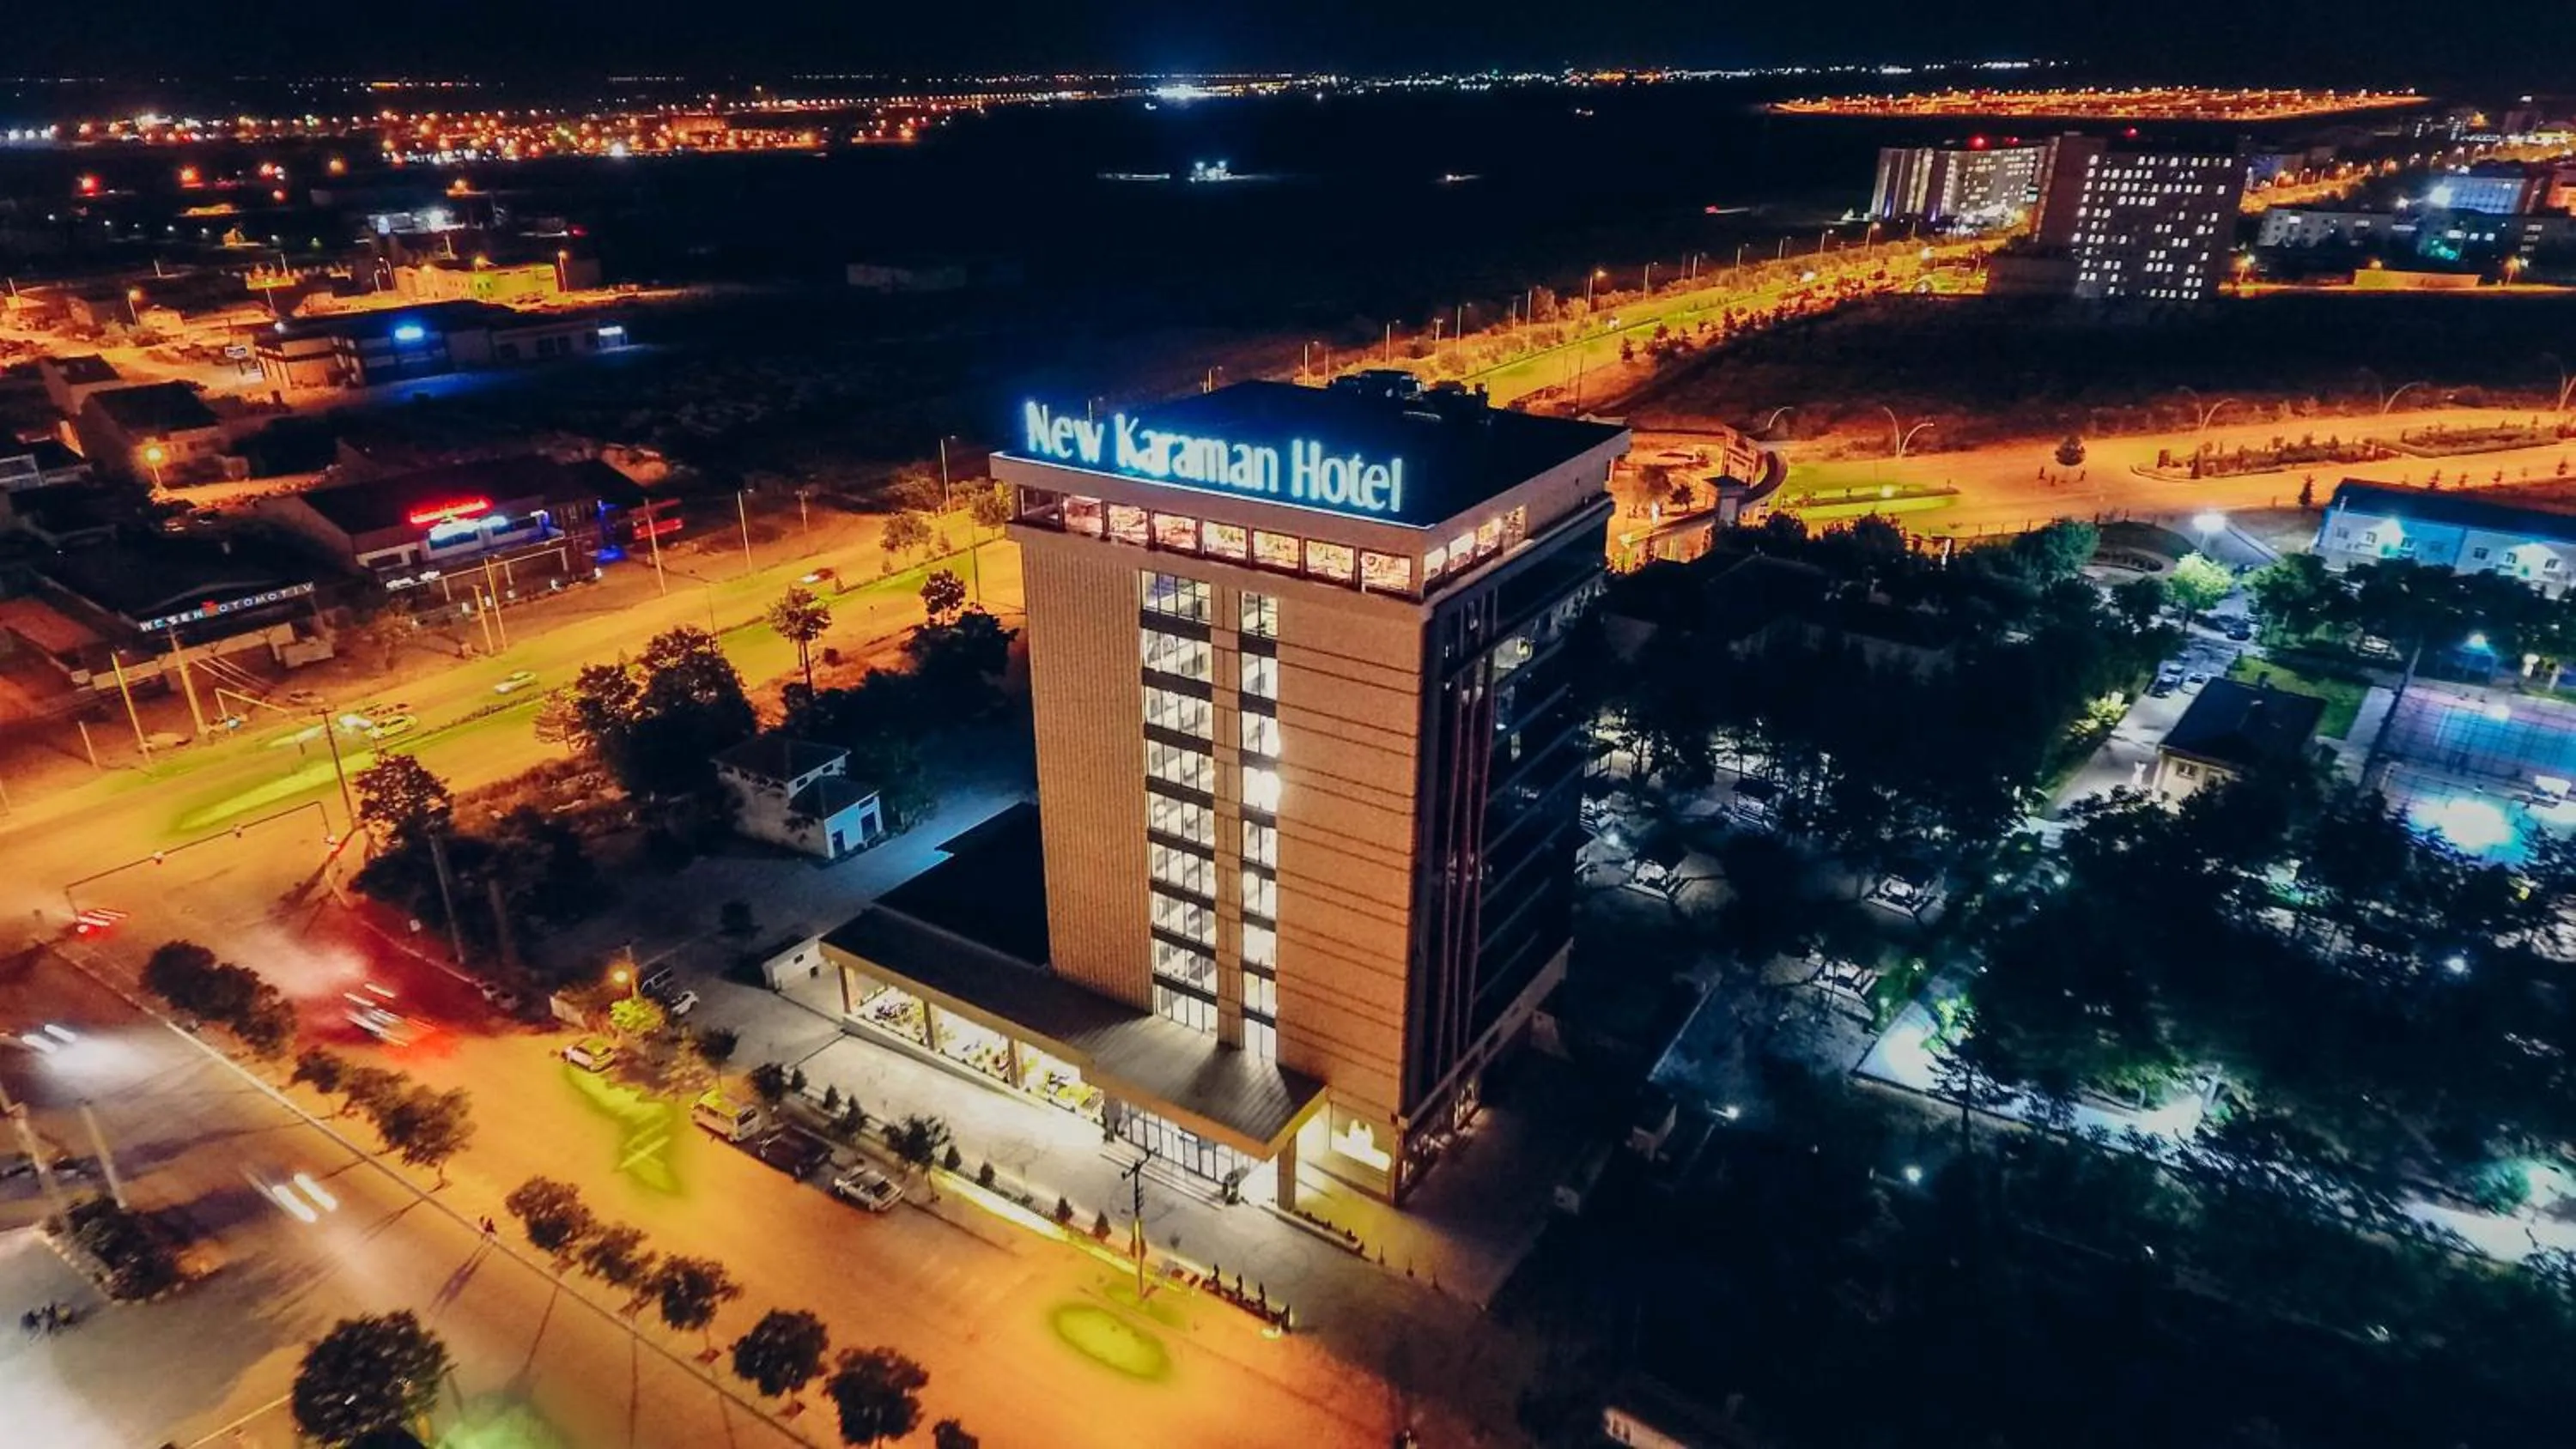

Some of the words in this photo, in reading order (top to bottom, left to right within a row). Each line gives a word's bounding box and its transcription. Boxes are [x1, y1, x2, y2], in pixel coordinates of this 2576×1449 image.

[1025, 401, 1103, 463] New
[1115, 413, 1278, 492] Karaman
[1292, 438, 1402, 512] Hotel
